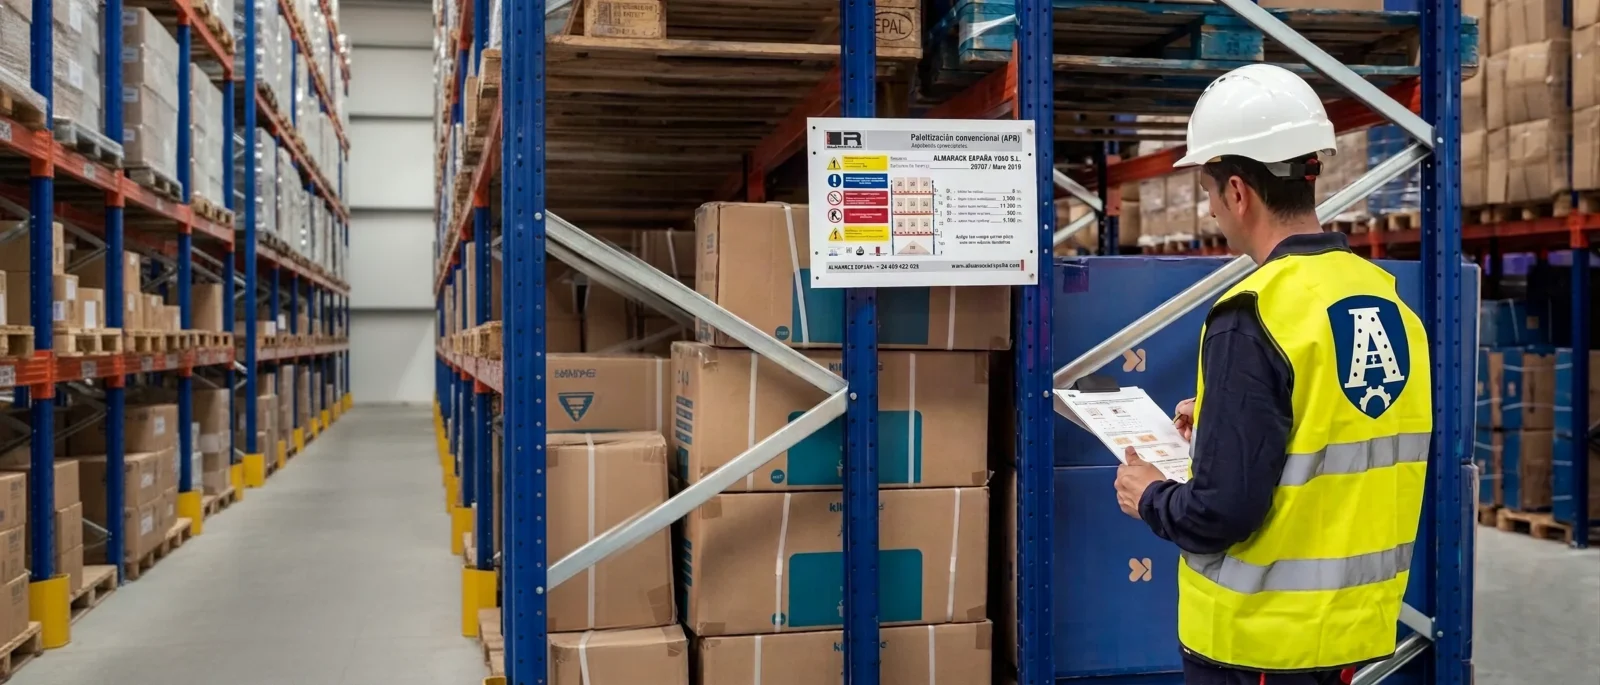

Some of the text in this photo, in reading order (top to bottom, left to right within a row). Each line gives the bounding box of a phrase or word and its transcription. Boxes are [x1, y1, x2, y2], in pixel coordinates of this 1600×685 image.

[955, 133, 999, 142] convencional
[1001, 134, 1021, 144] (APR)
[933, 154, 967, 162] ALMARACK
